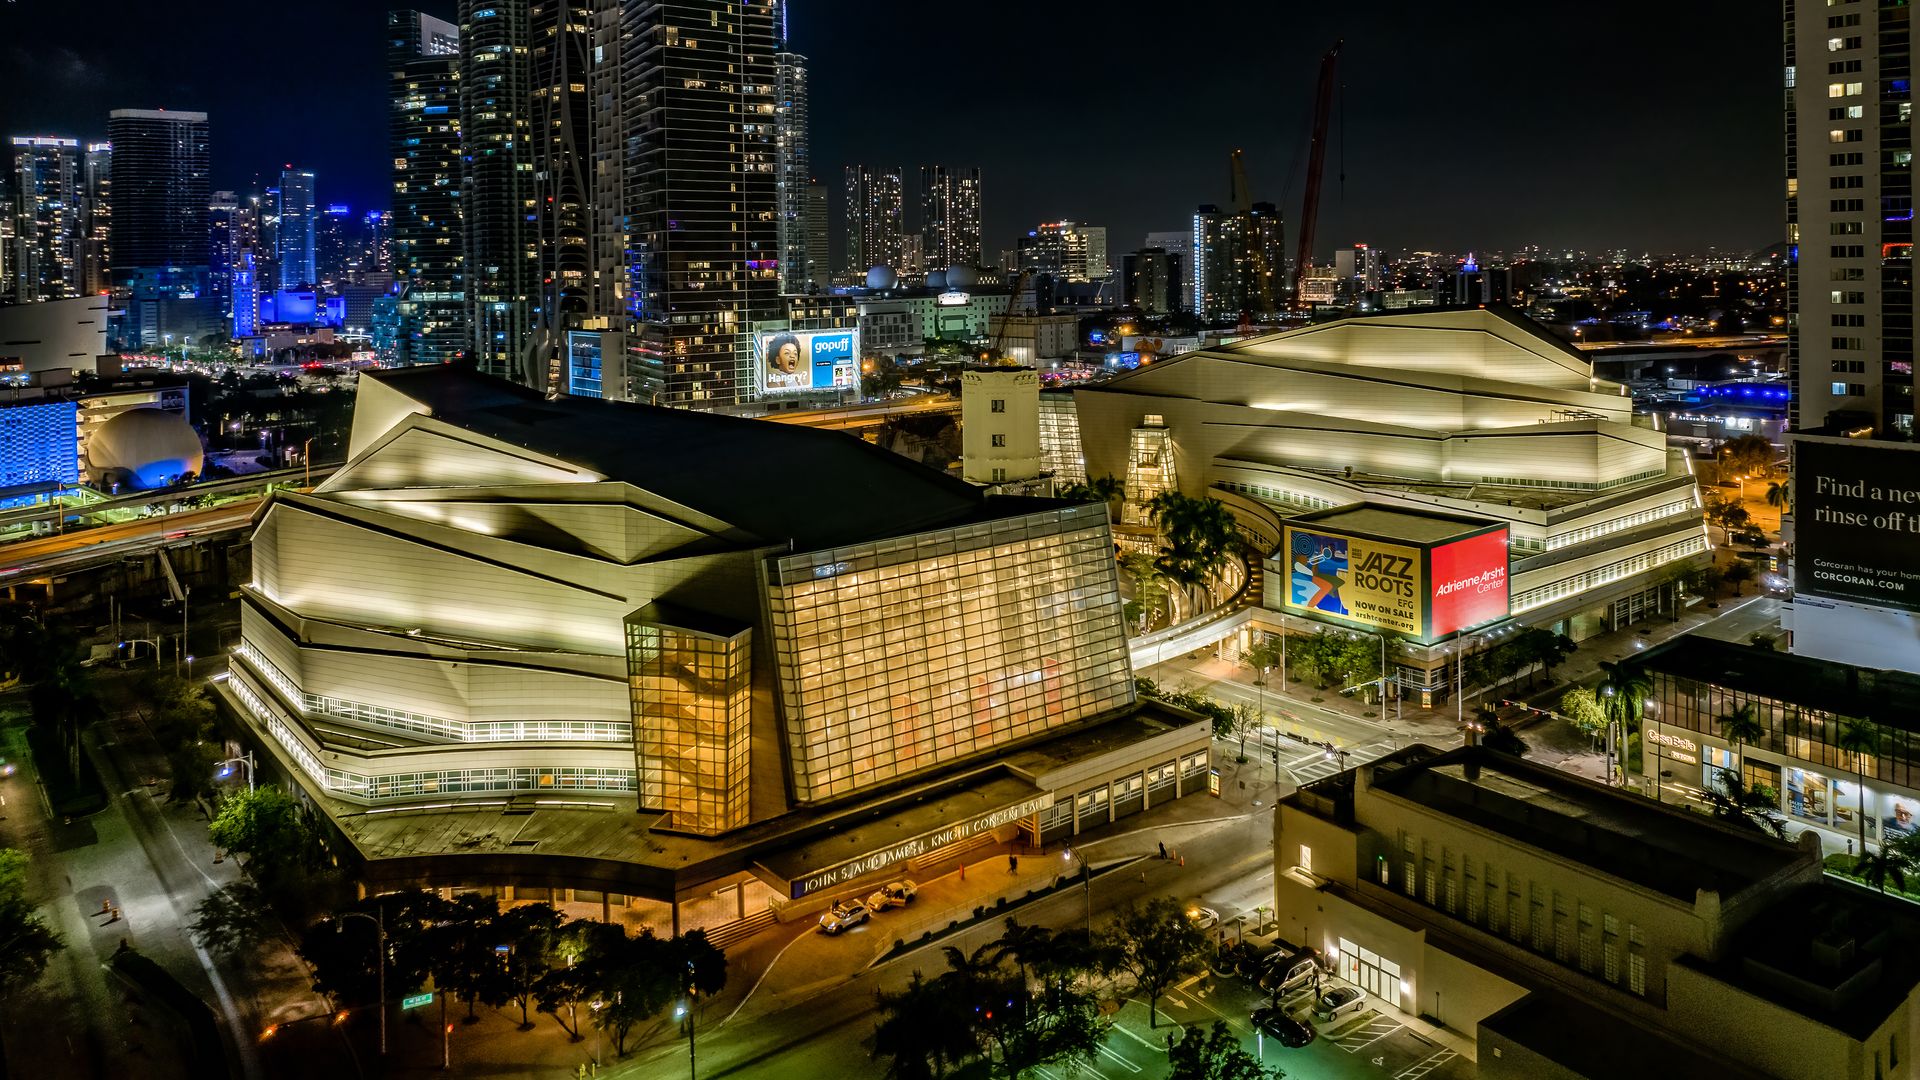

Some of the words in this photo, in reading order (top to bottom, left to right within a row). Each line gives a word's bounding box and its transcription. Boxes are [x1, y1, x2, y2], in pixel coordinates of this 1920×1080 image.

[815, 337, 849, 354] gopuff
[768, 371, 808, 383] Hangry?
[1703, 416, 1725, 425] Gallery
[1815, 475, 1865, 499] Find
[1870, 488, 1882, 501] a
[1815, 506, 1868, 527] rinse
[1873, 511, 1906, 531] off
[1354, 551, 1413, 580] JAZZ
[1814, 558, 1855, 571] Corcoran
[1857, 565, 1874, 574] has
[1876, 569, 1897, 577] your
[1355, 572, 1413, 597] ROOTS
[1436, 575, 1480, 597] Adrienne
[1480, 566, 1504, 583] Arsht
[1477, 578, 1504, 593] Center
[1814, 571, 1904, 591] CORCORAN.COM
[1355, 600, 1376, 611] NOW
[1378, 605, 1391, 615] ON
[1393, 609, 1414, 619] SALE
[1398, 598, 1413, 609] EFG
[1356, 612, 1414, 631] arshtcenter.org
[803, 872, 837, 893] JOHN
[853, 855, 879, 875] AND
[883, 844, 917, 864] JAMES
[931, 825, 969, 847] KNIGHT
[973, 808, 1018, 832] CONCERT
[1022, 799, 1044, 814] HALL
